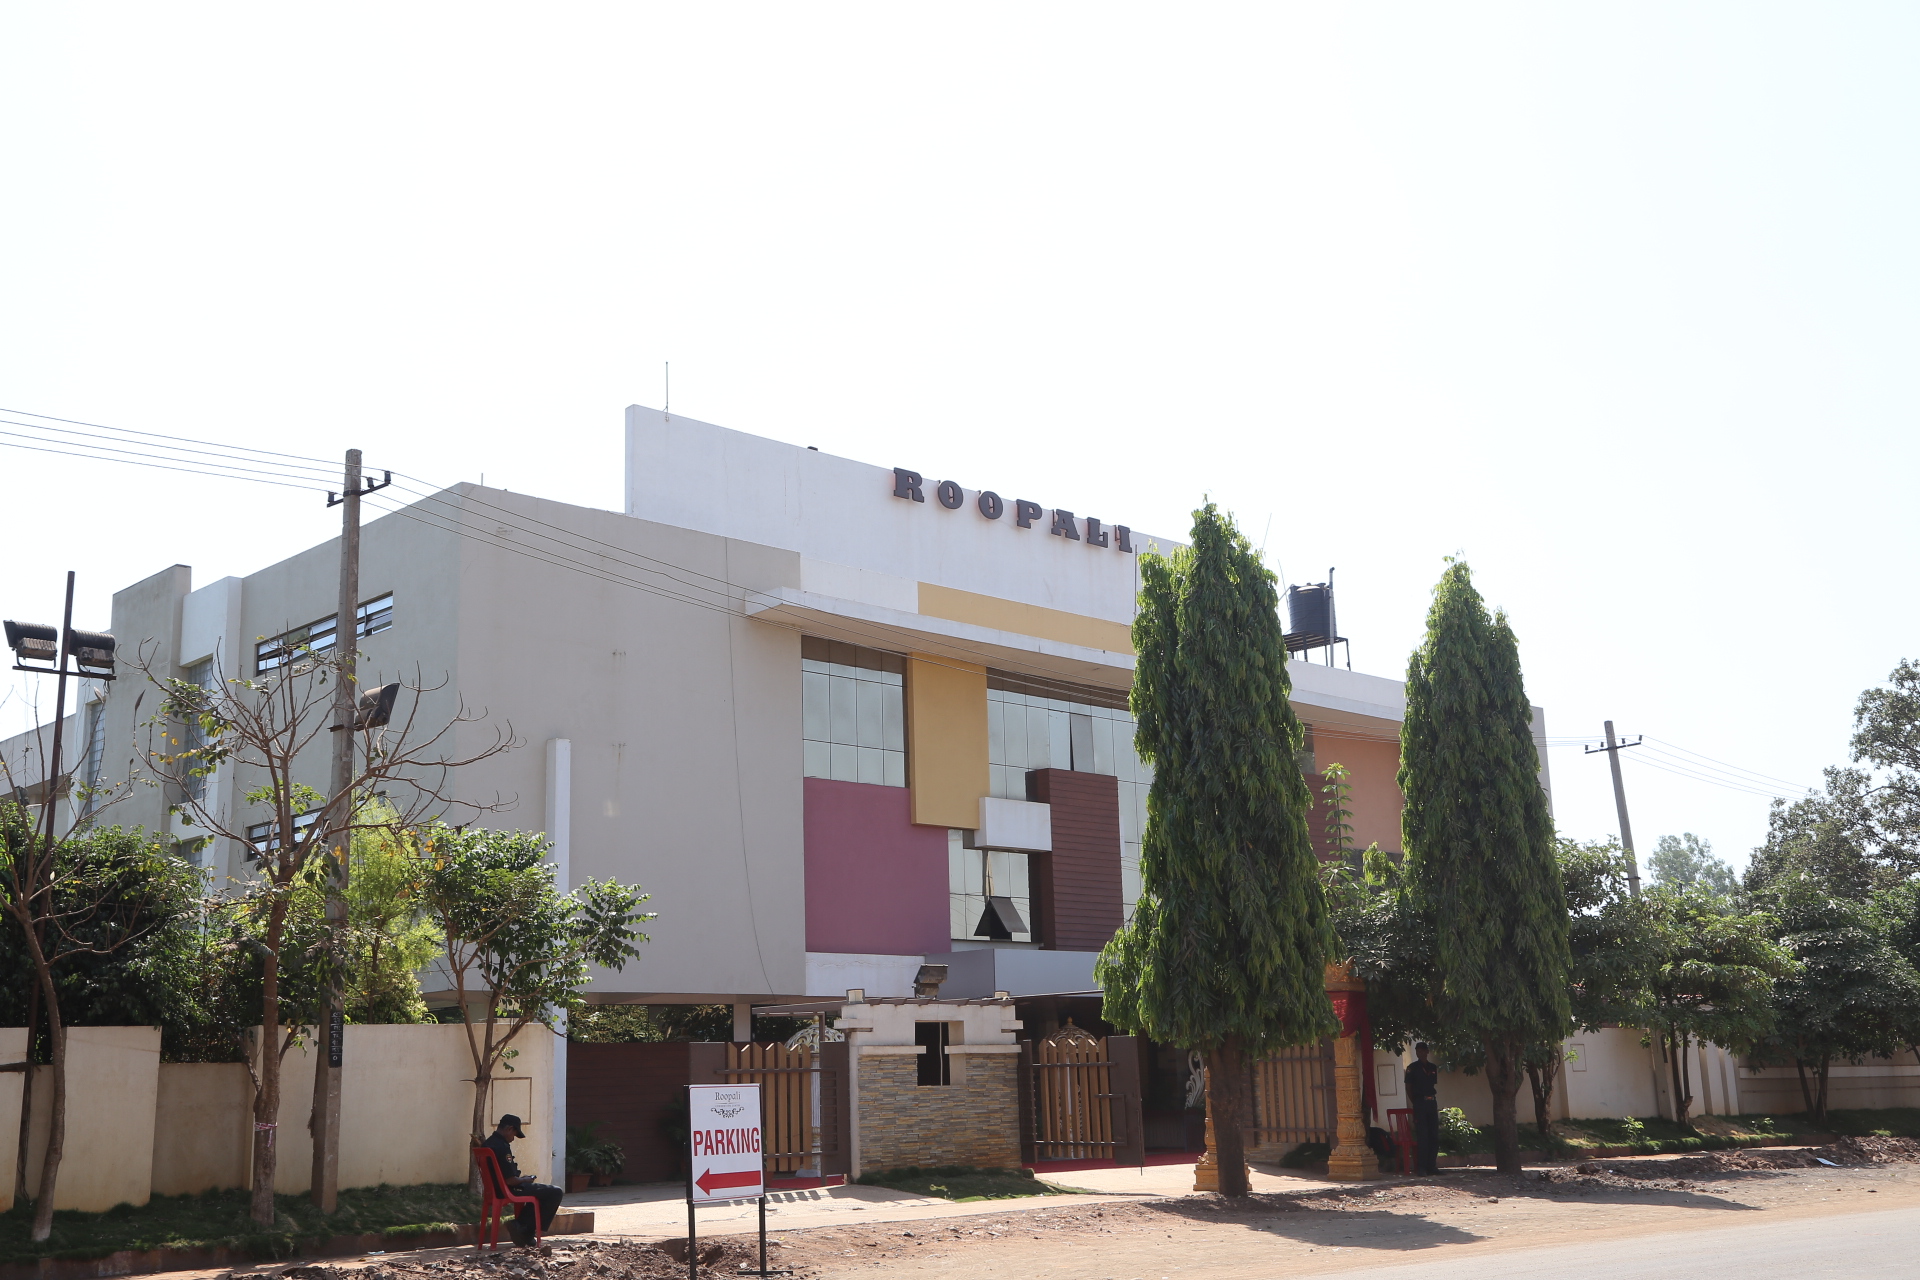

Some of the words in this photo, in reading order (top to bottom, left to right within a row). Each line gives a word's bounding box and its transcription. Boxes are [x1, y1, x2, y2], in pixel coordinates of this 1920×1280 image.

[893, 467, 1133, 553] ROOPALI
[715, 1091, 741, 1102] Roopali
[693, 1127, 760, 1156] PARKING
